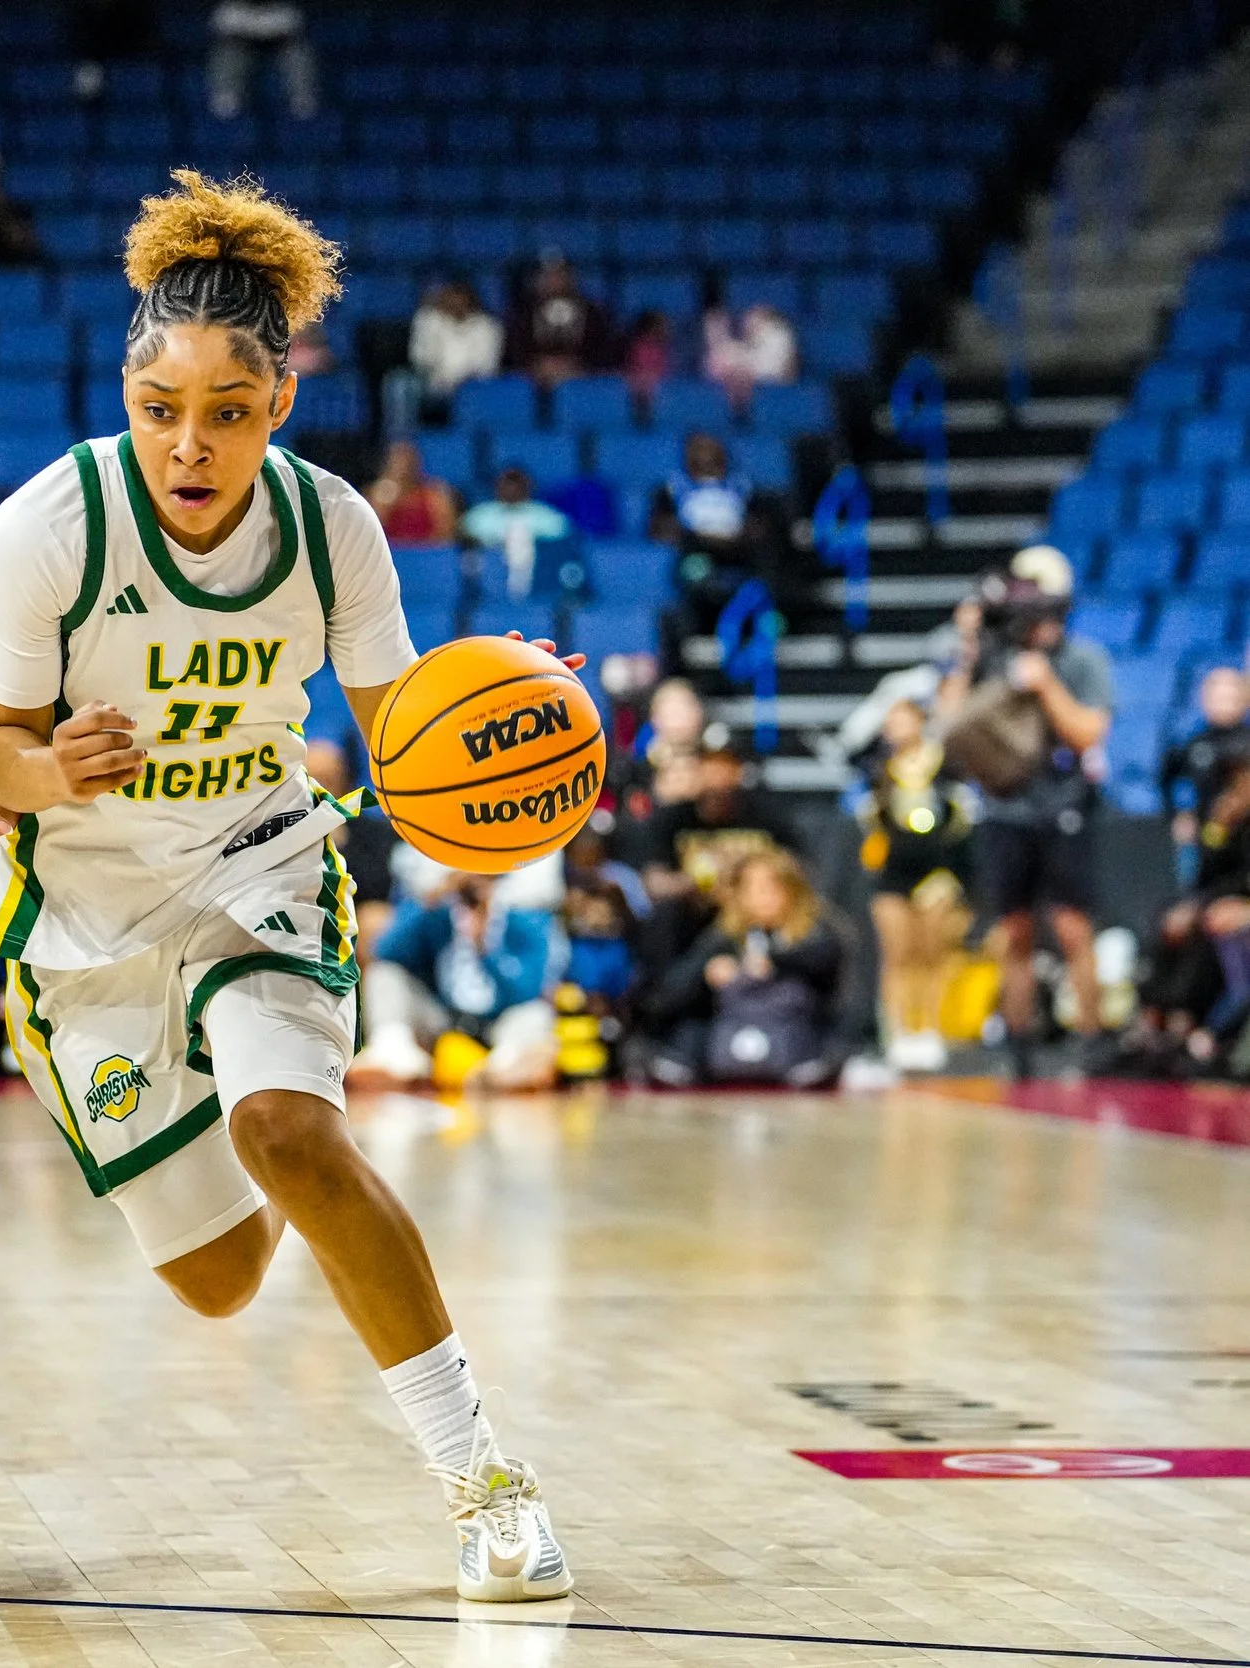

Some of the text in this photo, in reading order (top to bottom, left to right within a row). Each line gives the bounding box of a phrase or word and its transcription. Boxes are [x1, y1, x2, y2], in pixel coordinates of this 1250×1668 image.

[146, 637, 287, 692] LADY
[157, 699, 245, 744] 11
[459, 696, 572, 763] NCAA
[461, 760, 600, 825] Wilson
[85, 1066, 152, 1124] CHRISTIAN
